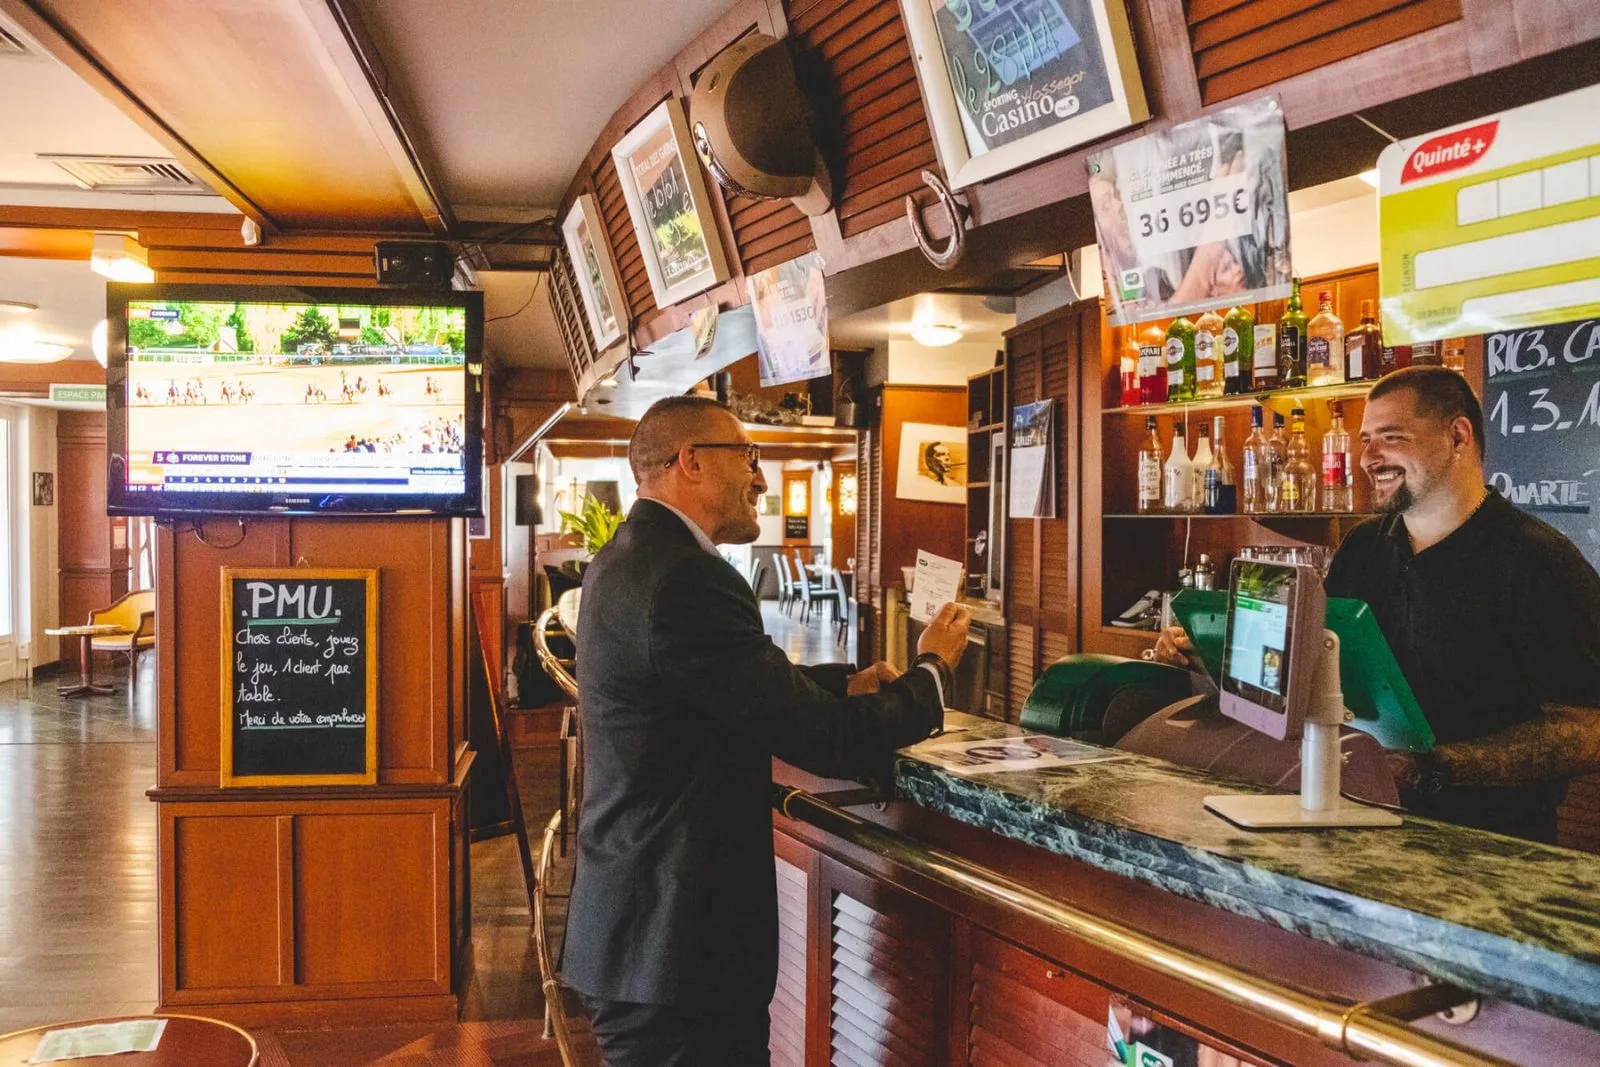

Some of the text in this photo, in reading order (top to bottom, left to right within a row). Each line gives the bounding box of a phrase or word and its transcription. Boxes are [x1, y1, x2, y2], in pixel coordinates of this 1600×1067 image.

[983, 89, 1018, 112] SPORTING
[982, 95, 1054, 137] Casino
[1140, 188, 1248, 237] 36 695€
[57, 391, 89, 400] ESPACE
[157, 453, 247, 462] 5 FOREVER STONE
[236, 626, 358, 658] Chers clients, jouez
[237, 651, 351, 685] le jeu, 1 client par
[237, 682, 281, 703] table.
[240, 709, 265, 727] Merci
[271, 711, 285, 724] de
[288, 710, 311, 724] votre
